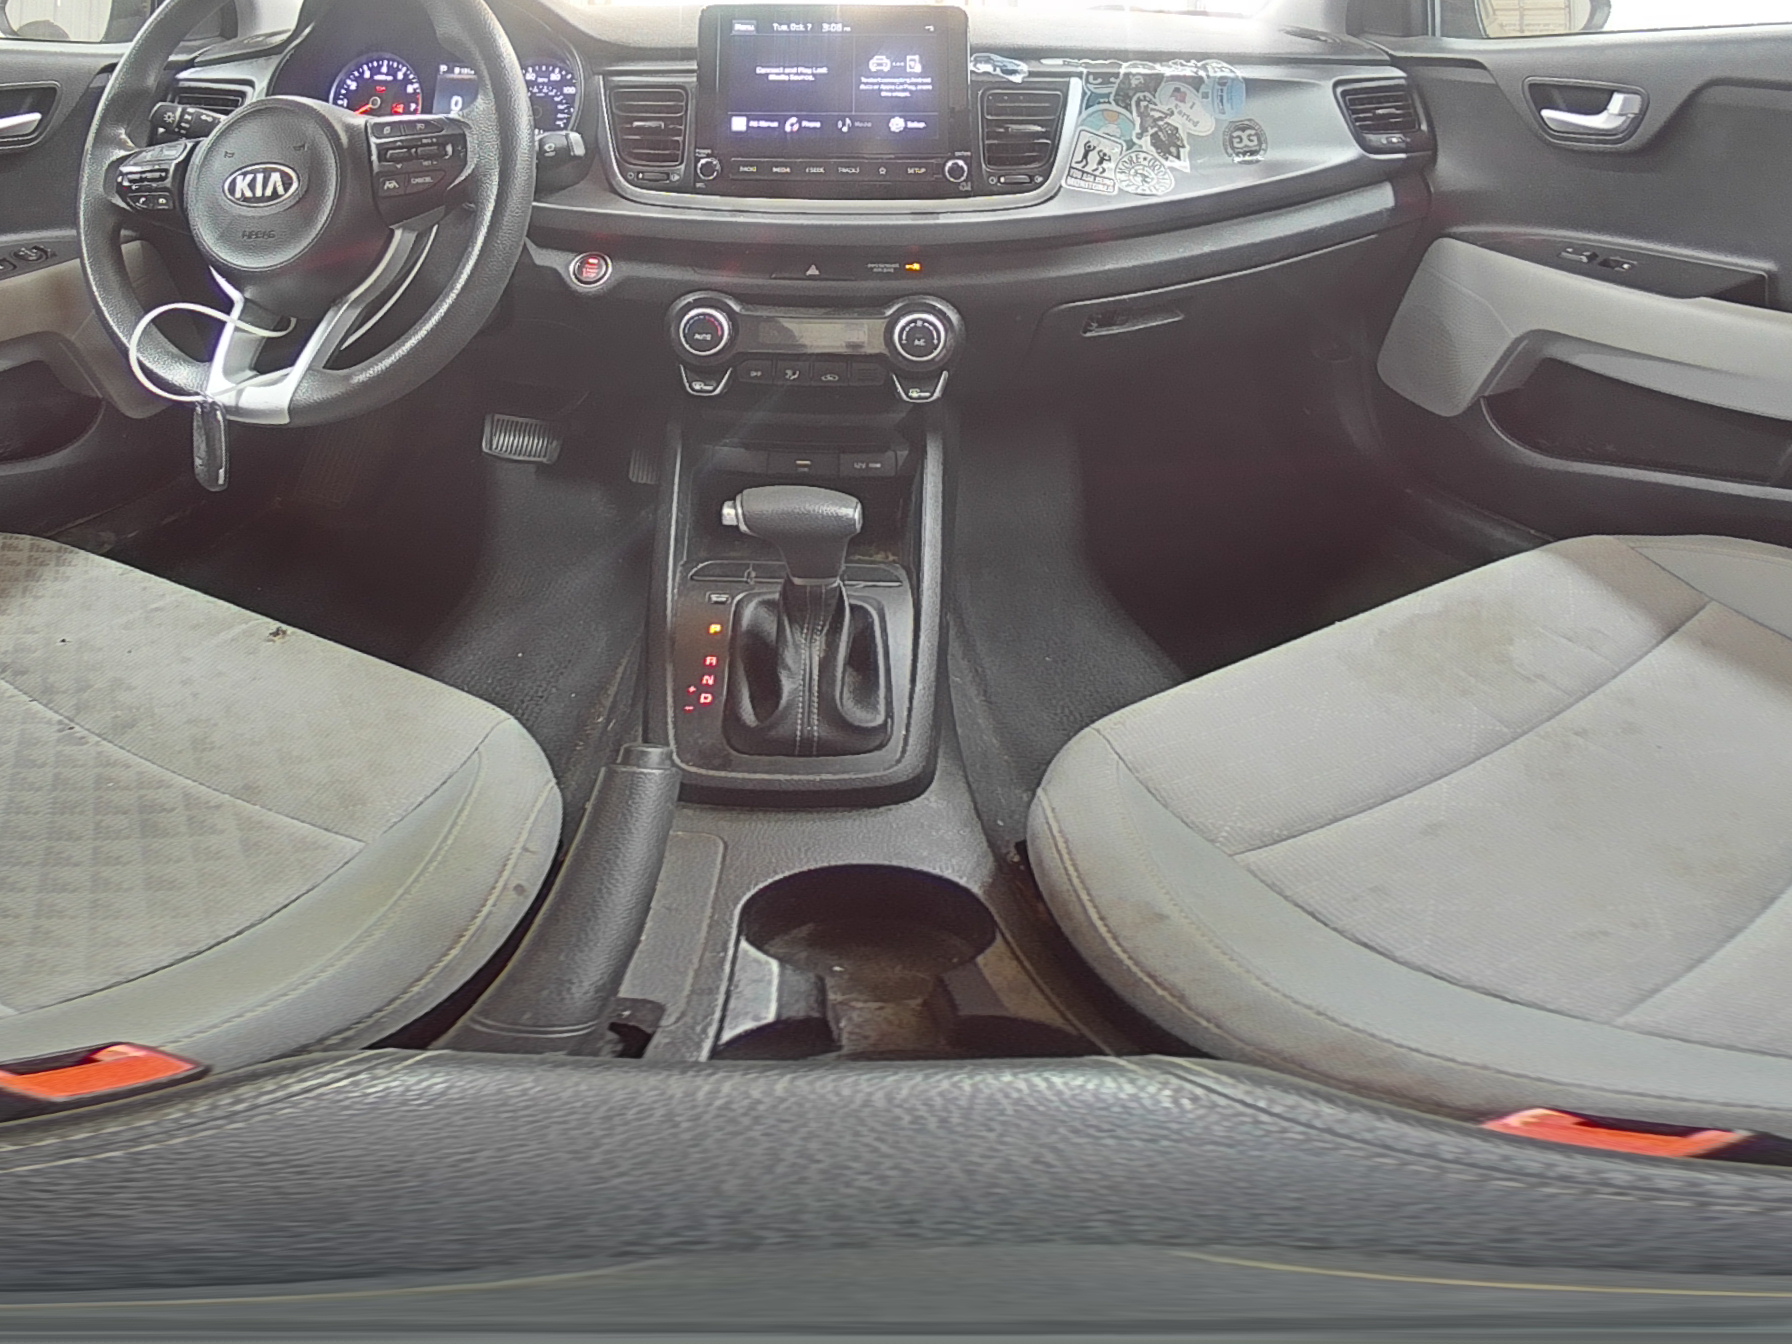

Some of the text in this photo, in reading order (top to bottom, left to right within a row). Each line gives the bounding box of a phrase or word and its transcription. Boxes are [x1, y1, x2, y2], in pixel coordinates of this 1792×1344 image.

[440, 64, 448, 75] P
[450, 95, 462, 112] 0
[234, 171, 287, 199] KIA
[709, 623, 722, 635] P
[701, 674, 715, 686] N
[699, 692, 713, 704] D
